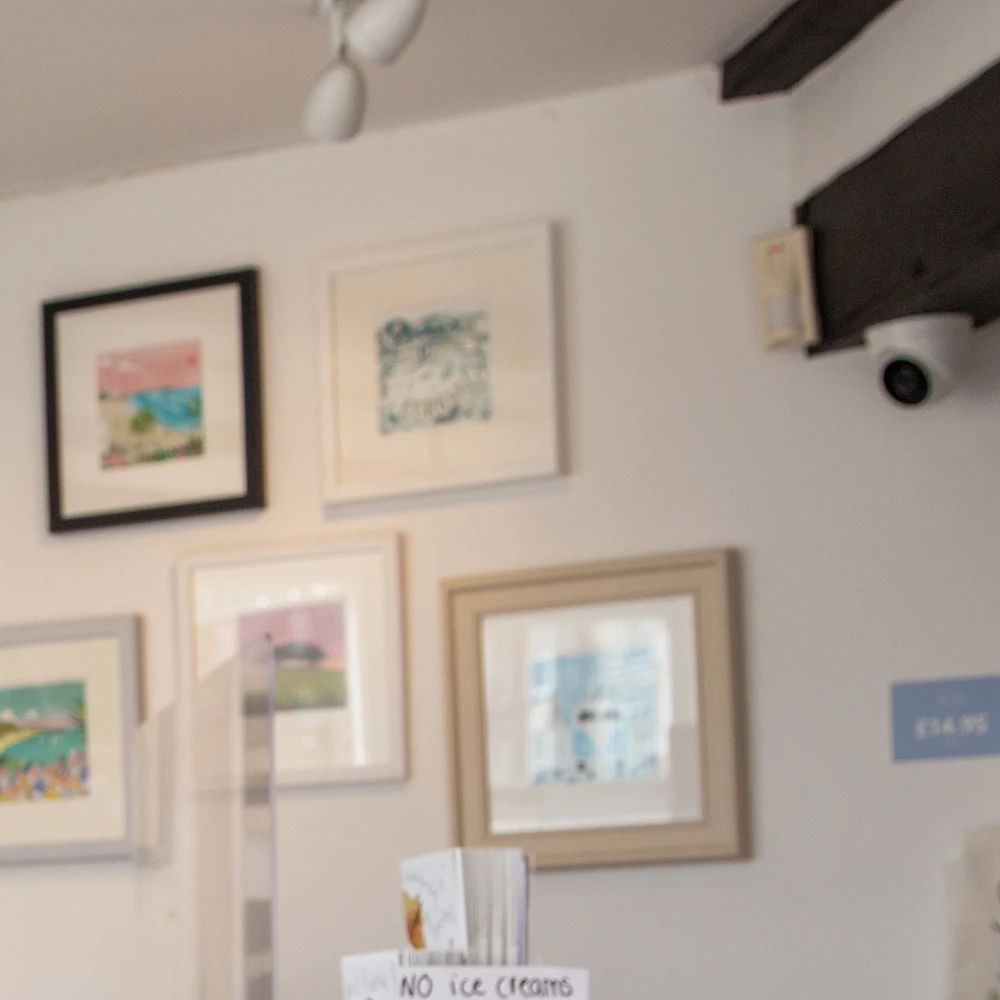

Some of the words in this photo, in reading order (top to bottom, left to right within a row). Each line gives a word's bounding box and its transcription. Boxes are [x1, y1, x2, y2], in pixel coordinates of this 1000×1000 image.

[400, 973, 434, 999] NO
[449, 972, 487, 998] ice
[495, 974, 574, 999] creams
